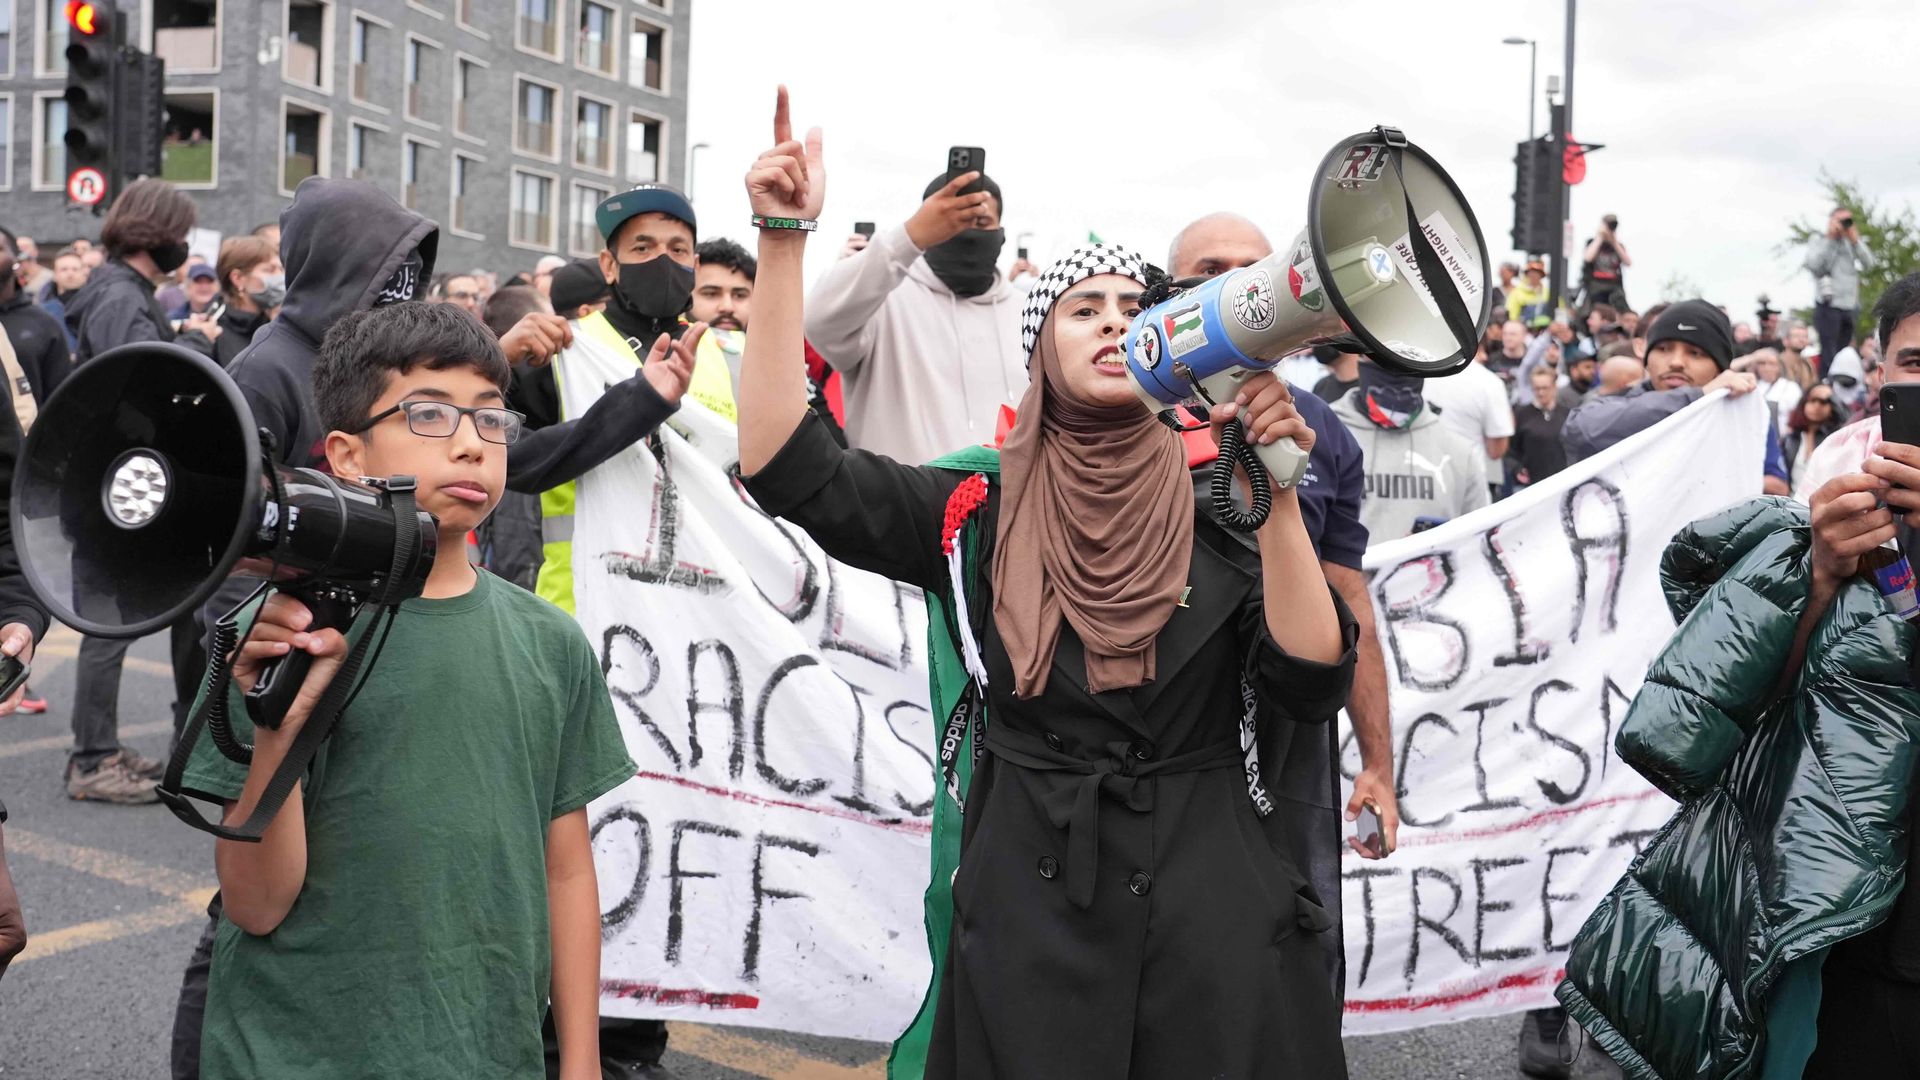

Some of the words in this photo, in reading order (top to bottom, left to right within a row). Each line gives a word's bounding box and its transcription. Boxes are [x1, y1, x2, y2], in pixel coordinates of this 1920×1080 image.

[767, 218, 797, 229] GAZA
[798, 219, 817, 232] SAVE
[1420, 223, 1450, 257] RIGHT
[1446, 255, 1478, 295] HUMAN
[1361, 472, 1434, 501] PUMA
[1364, 475, 1629, 694] BIA
[941, 703, 969, 762] adidas
[588, 803, 826, 984] OFF
